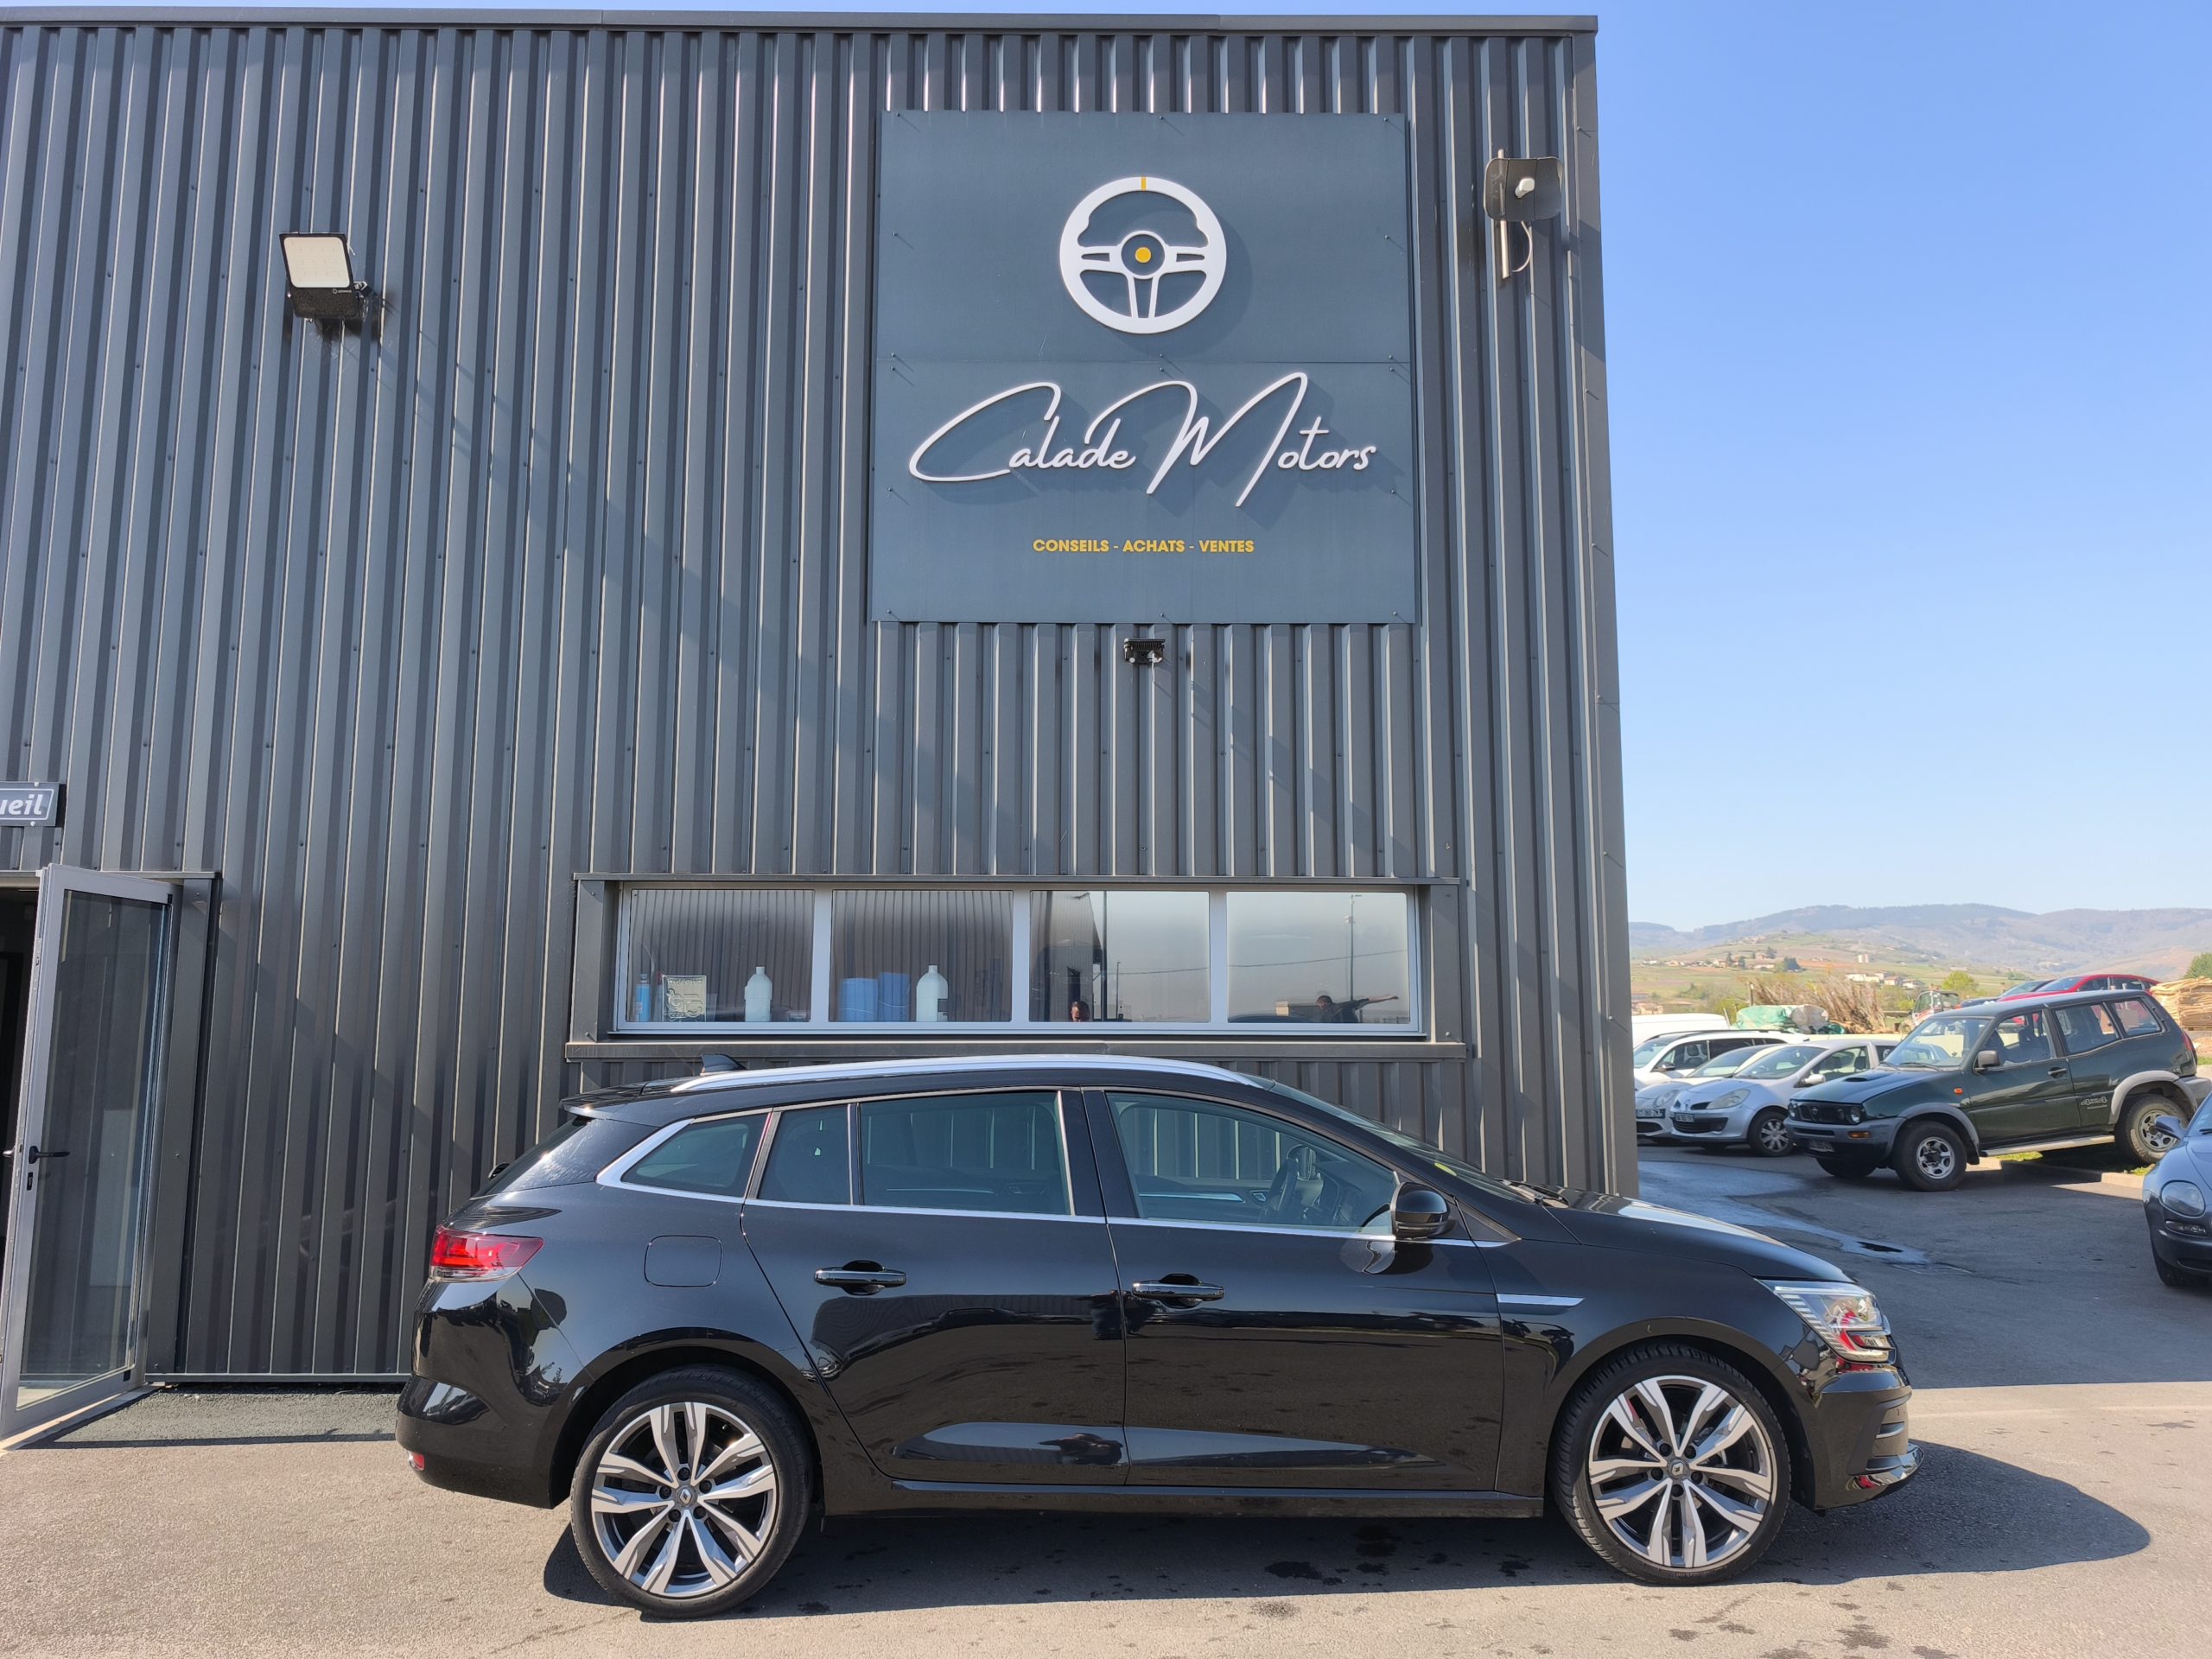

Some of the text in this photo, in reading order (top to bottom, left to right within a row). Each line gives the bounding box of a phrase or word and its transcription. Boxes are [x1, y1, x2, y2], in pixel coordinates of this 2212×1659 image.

[909, 372, 1376, 507] Calade Motors
[1033, 539, 1109, 552] CONSEILS
[1122, 539, 1185, 552] ACHATS
[1199, 540, 1255, 552] VENTES
